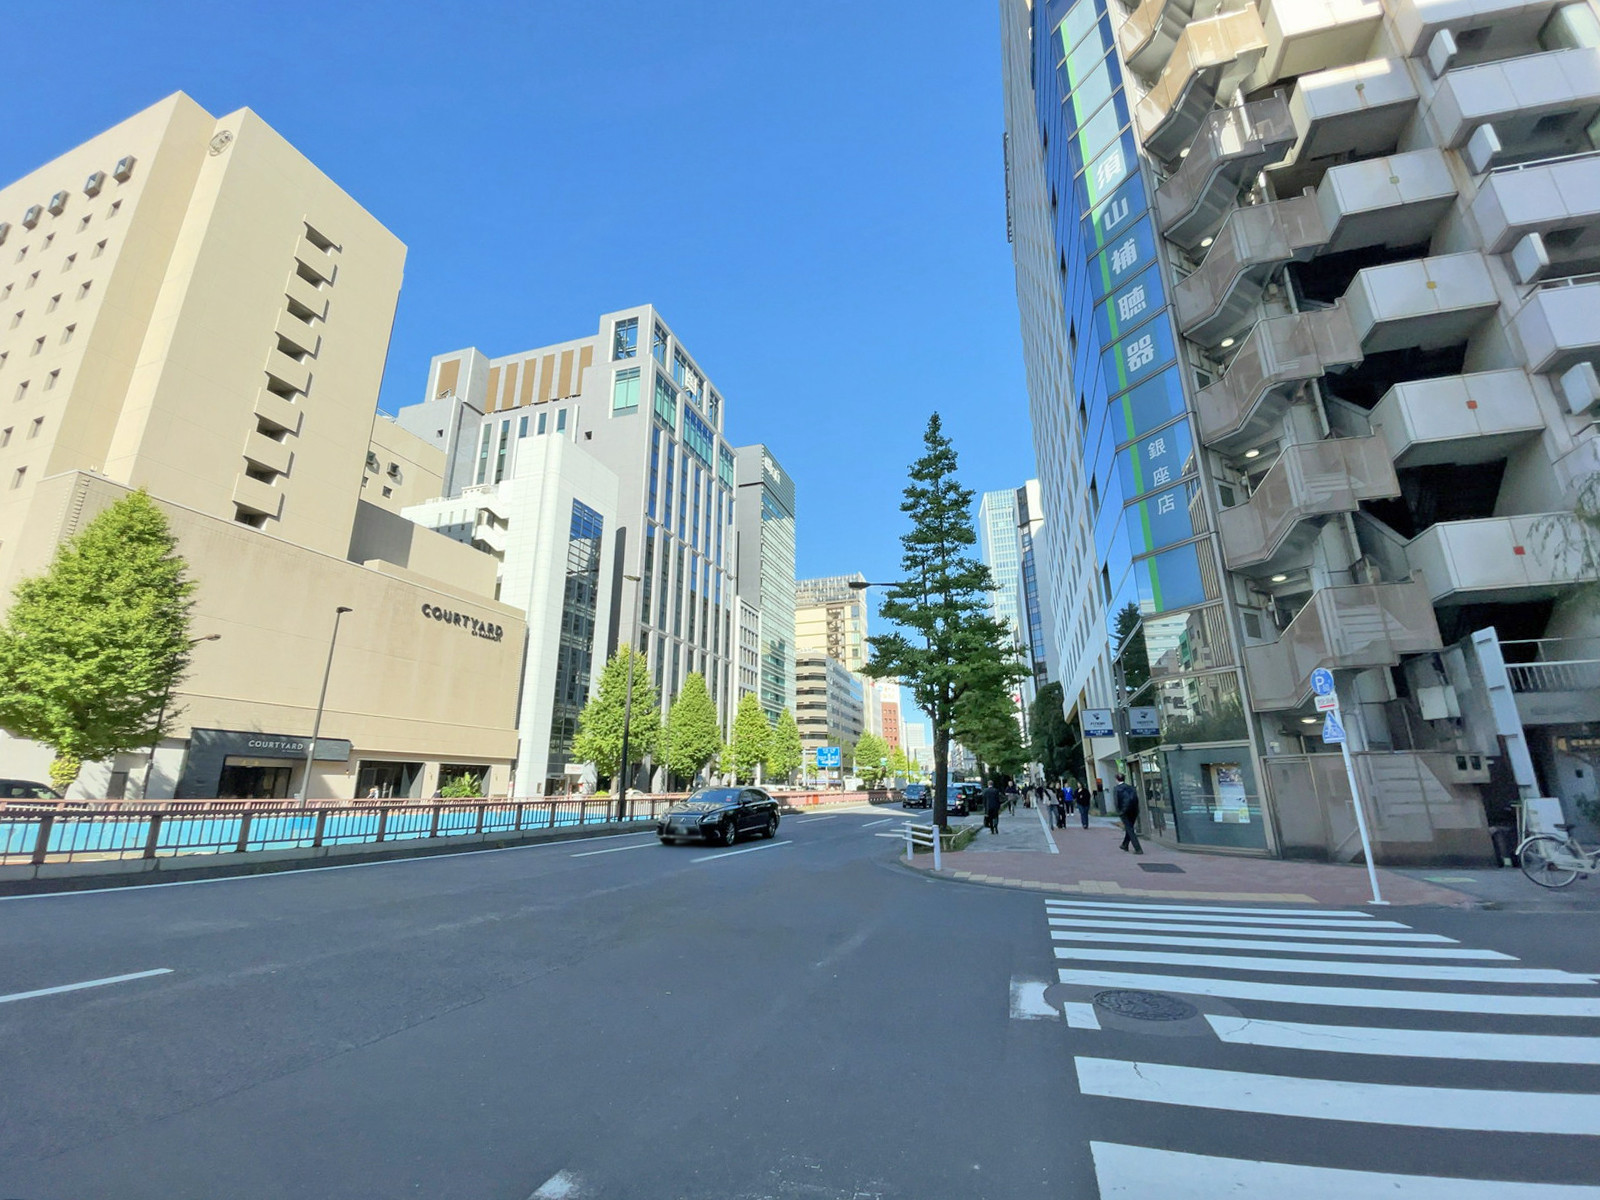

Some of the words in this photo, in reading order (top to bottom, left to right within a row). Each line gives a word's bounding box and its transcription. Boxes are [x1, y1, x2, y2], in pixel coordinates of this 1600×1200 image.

[1096, 150, 1155, 373] 須山補聴器
[1147, 437, 1176, 515] 銀座店
[421, 603, 504, 639] COURTYARD
[1315, 676, 1325, 693] P
[248, 740, 304, 750] COURTYARD
